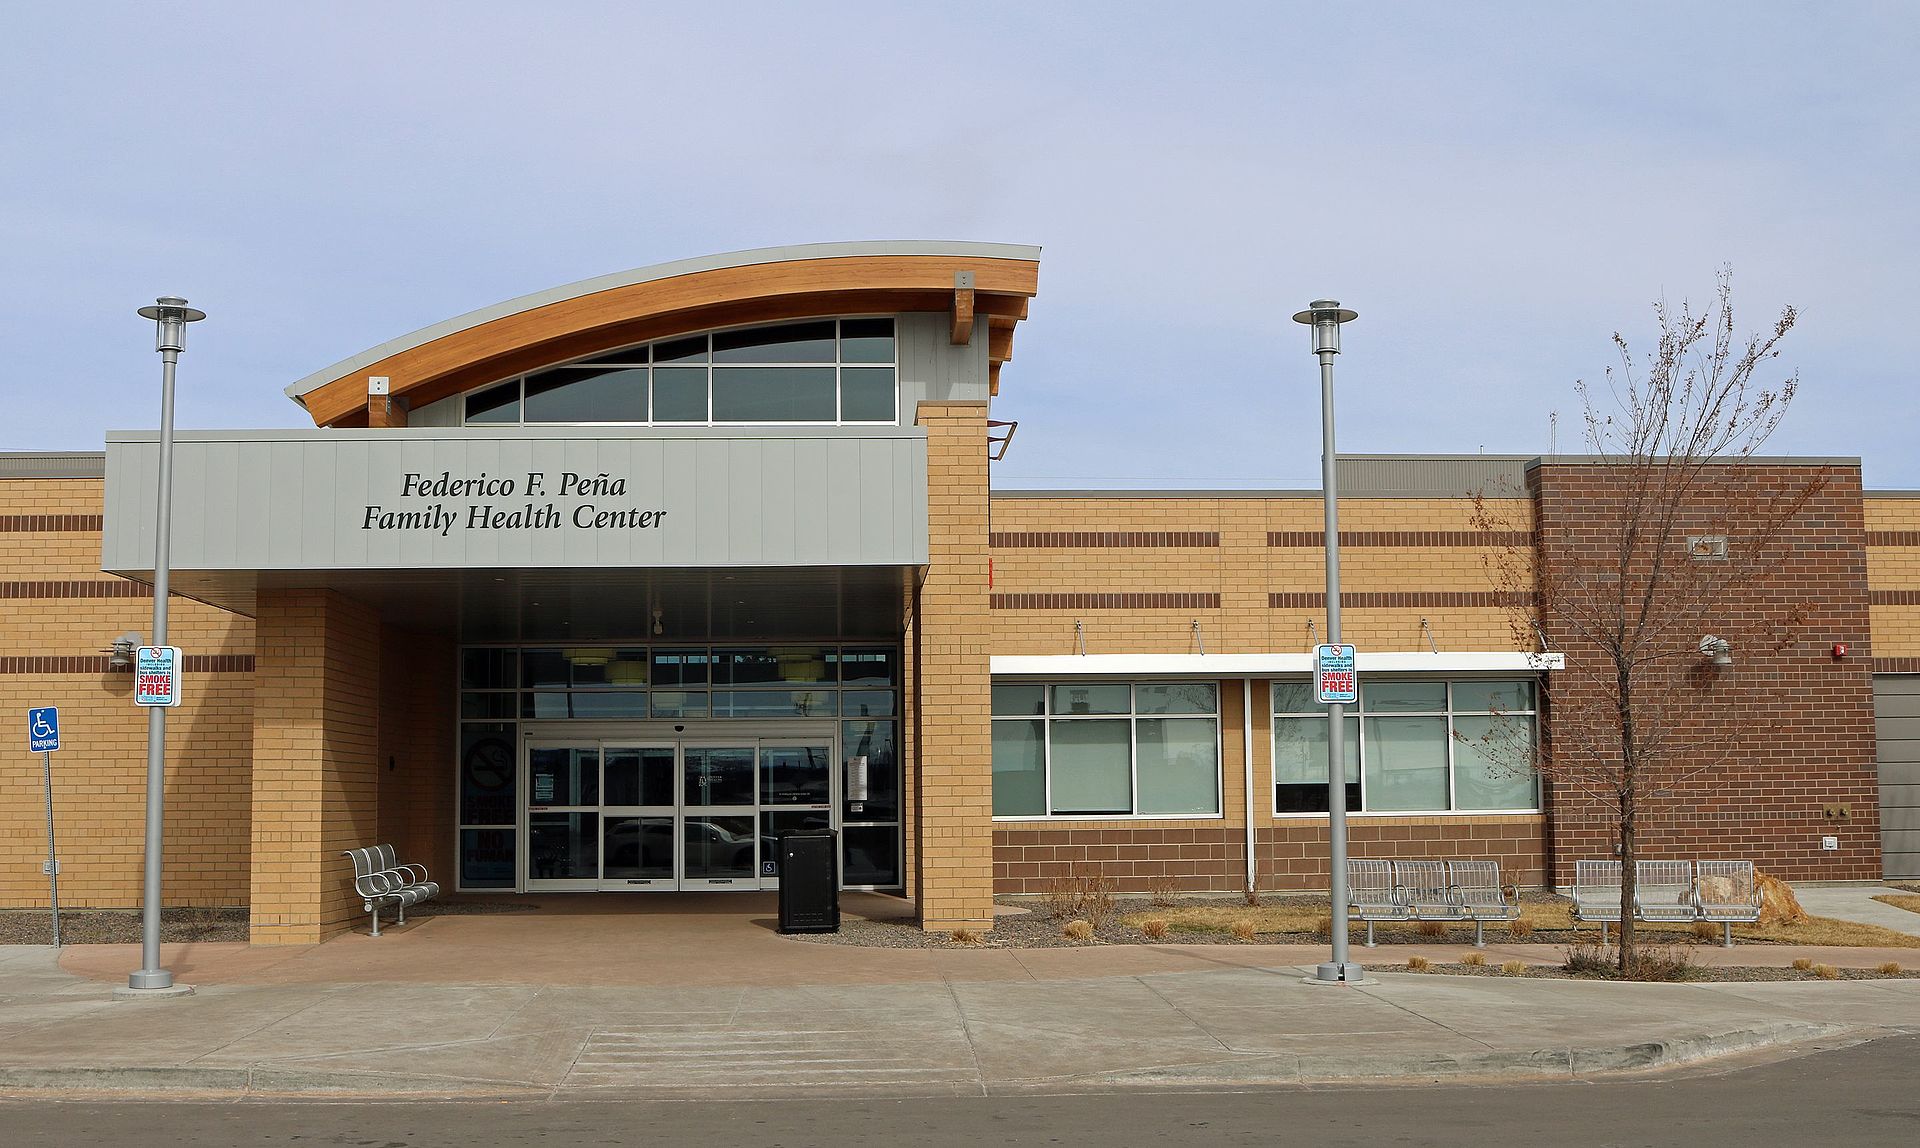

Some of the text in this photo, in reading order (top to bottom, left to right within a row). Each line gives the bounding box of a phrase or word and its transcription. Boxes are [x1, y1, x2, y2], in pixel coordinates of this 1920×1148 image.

[400, 472, 627, 497] Federico F. Peña
[362, 503, 667, 536] Family Health Center
[139, 675, 171, 683] SMOKE
[1322, 672, 1352, 681] SMOKE
[139, 684, 171, 695] FREE
[1322, 681, 1353, 692] FREE
[32, 739, 57, 748] PARKING
[477, 830, 504, 848] NO
